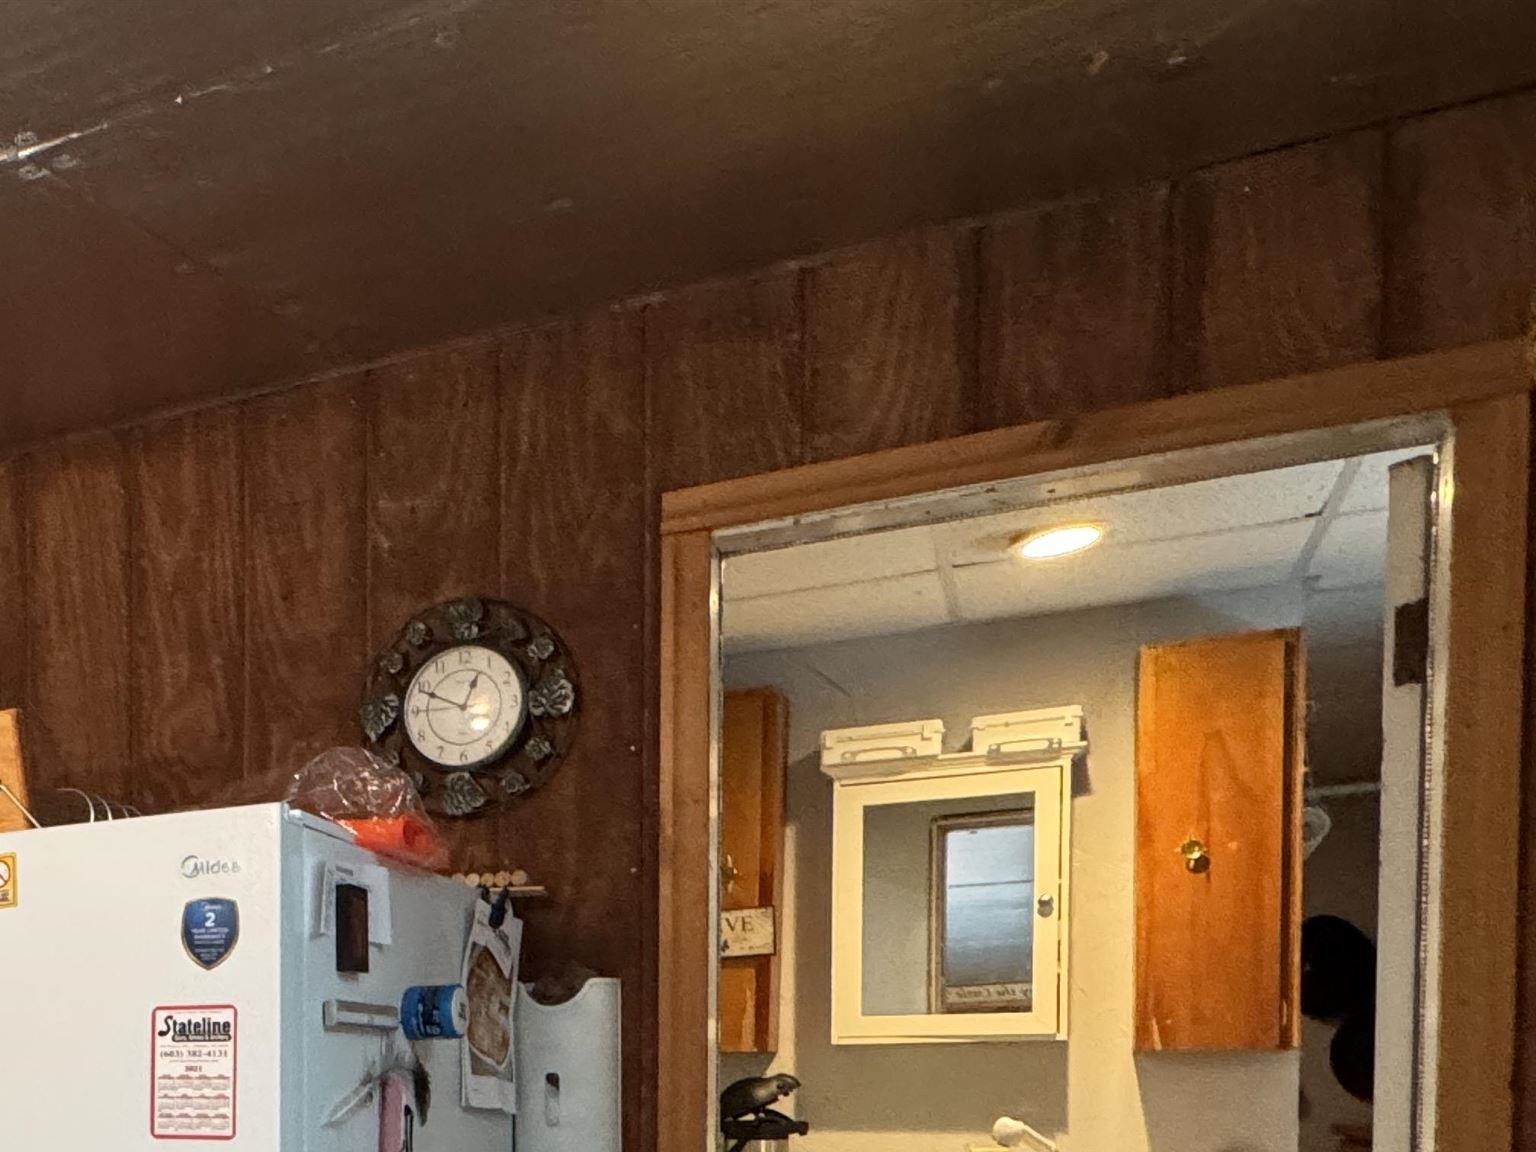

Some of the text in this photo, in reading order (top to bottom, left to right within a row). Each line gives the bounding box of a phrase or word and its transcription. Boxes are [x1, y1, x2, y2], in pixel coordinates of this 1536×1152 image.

[458, 651, 472, 664] 12
[486, 656, 492, 666] 1
[434, 661, 446, 673] 11
[502, 671, 511, 684] 2
[418, 680, 431, 692] 10
[511, 695, 519, 707] 3
[411, 705, 419, 716] 9
[418, 730, 426, 742] 8
[437, 746, 445, 758] 7
[459, 749, 469, 761] 6
[181, 855, 240, 879] Midea
[205, 912, 216, 927] 2
[158, 1015, 231, 1037] Stateline
